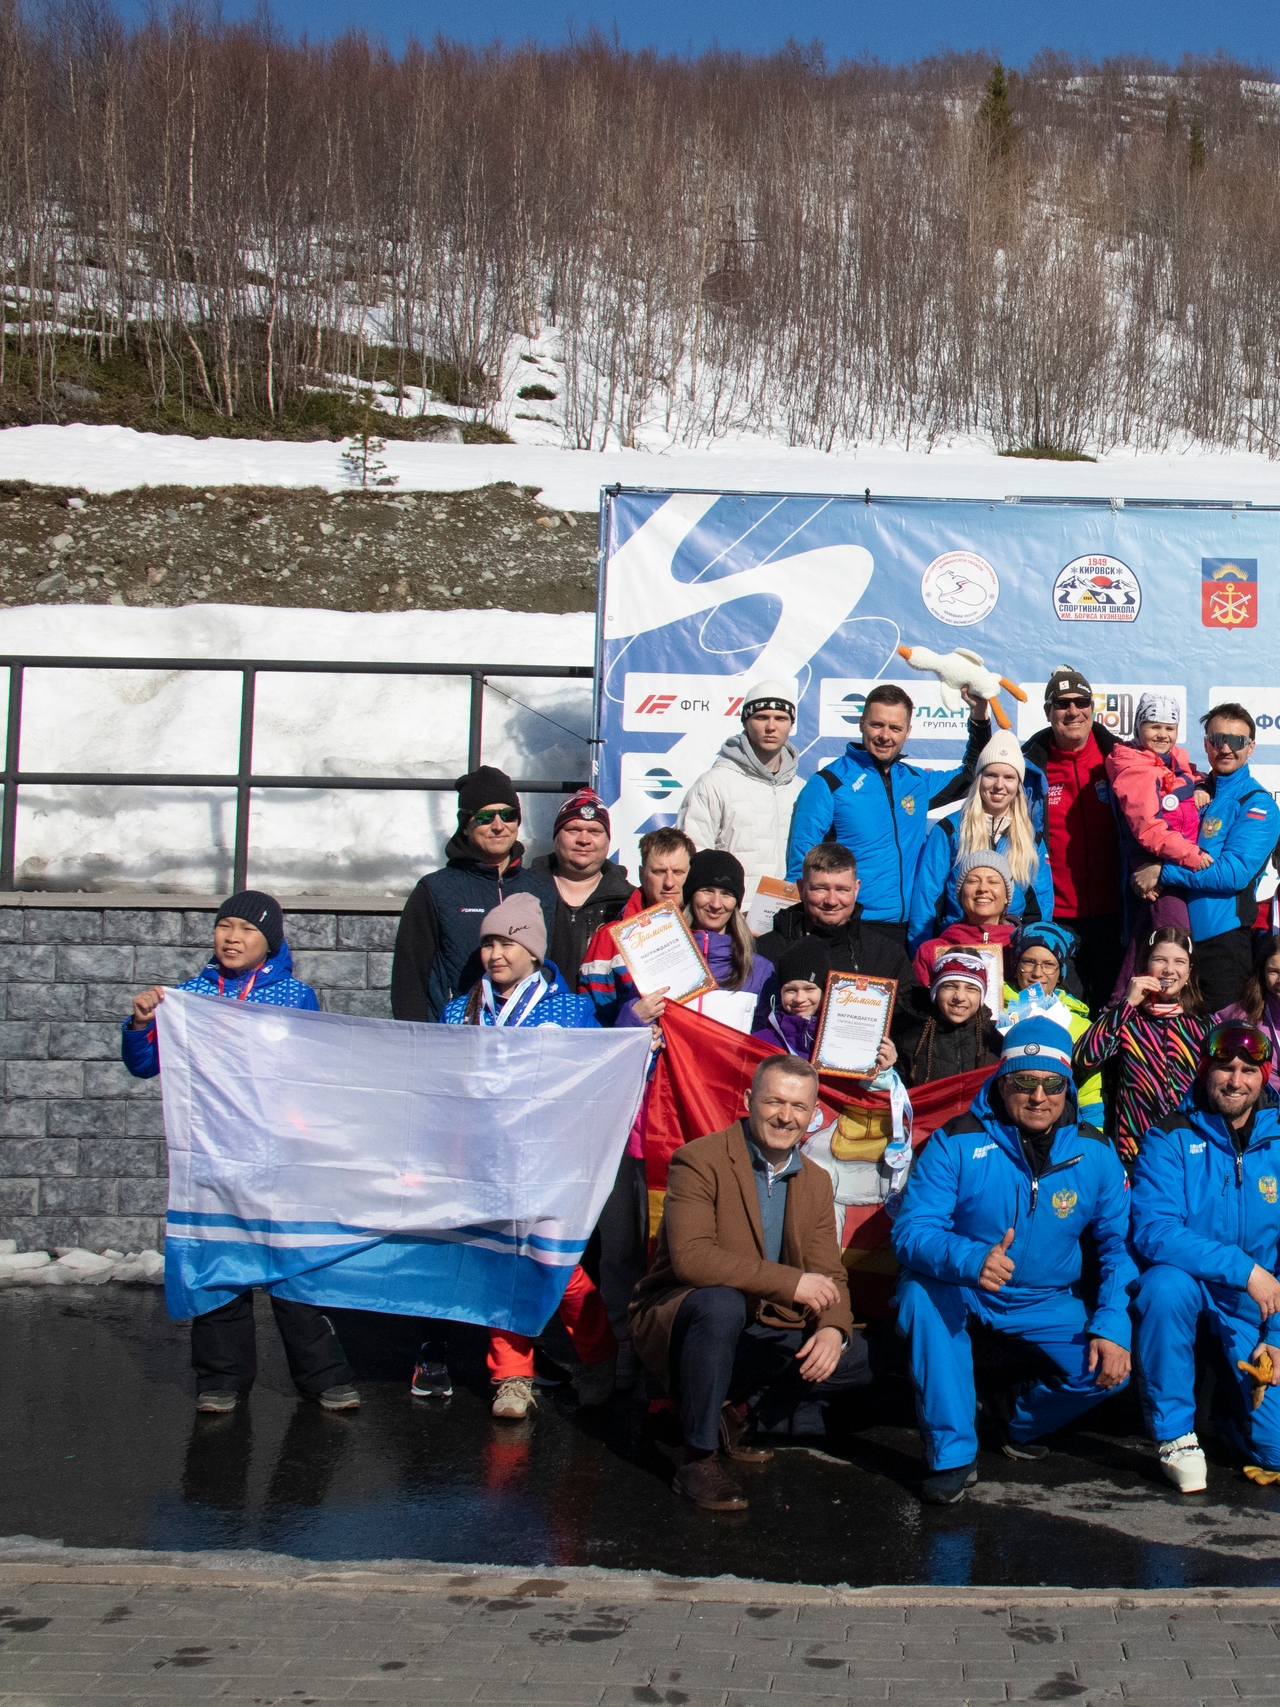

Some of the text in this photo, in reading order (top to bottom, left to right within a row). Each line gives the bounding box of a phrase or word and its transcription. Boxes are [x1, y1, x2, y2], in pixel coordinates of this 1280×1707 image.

[1088, 558, 1108, 566] 1949
[1079, 566, 1116, 575] КИРОВСК
[1059, 604, 1136, 614] СПОРТИВНАЯ ШКОЛА
[680, 700, 710, 712] ФГК
[508, 924, 530, 936] love
[628, 921, 673, 950] Грамота
[640, 938, 680, 960] НАГРАЖДАЕТСЯ
[836, 988, 882, 1006] Грамота
[836, 1012, 878, 1022] НАГРАЖДАЕТСЯ
